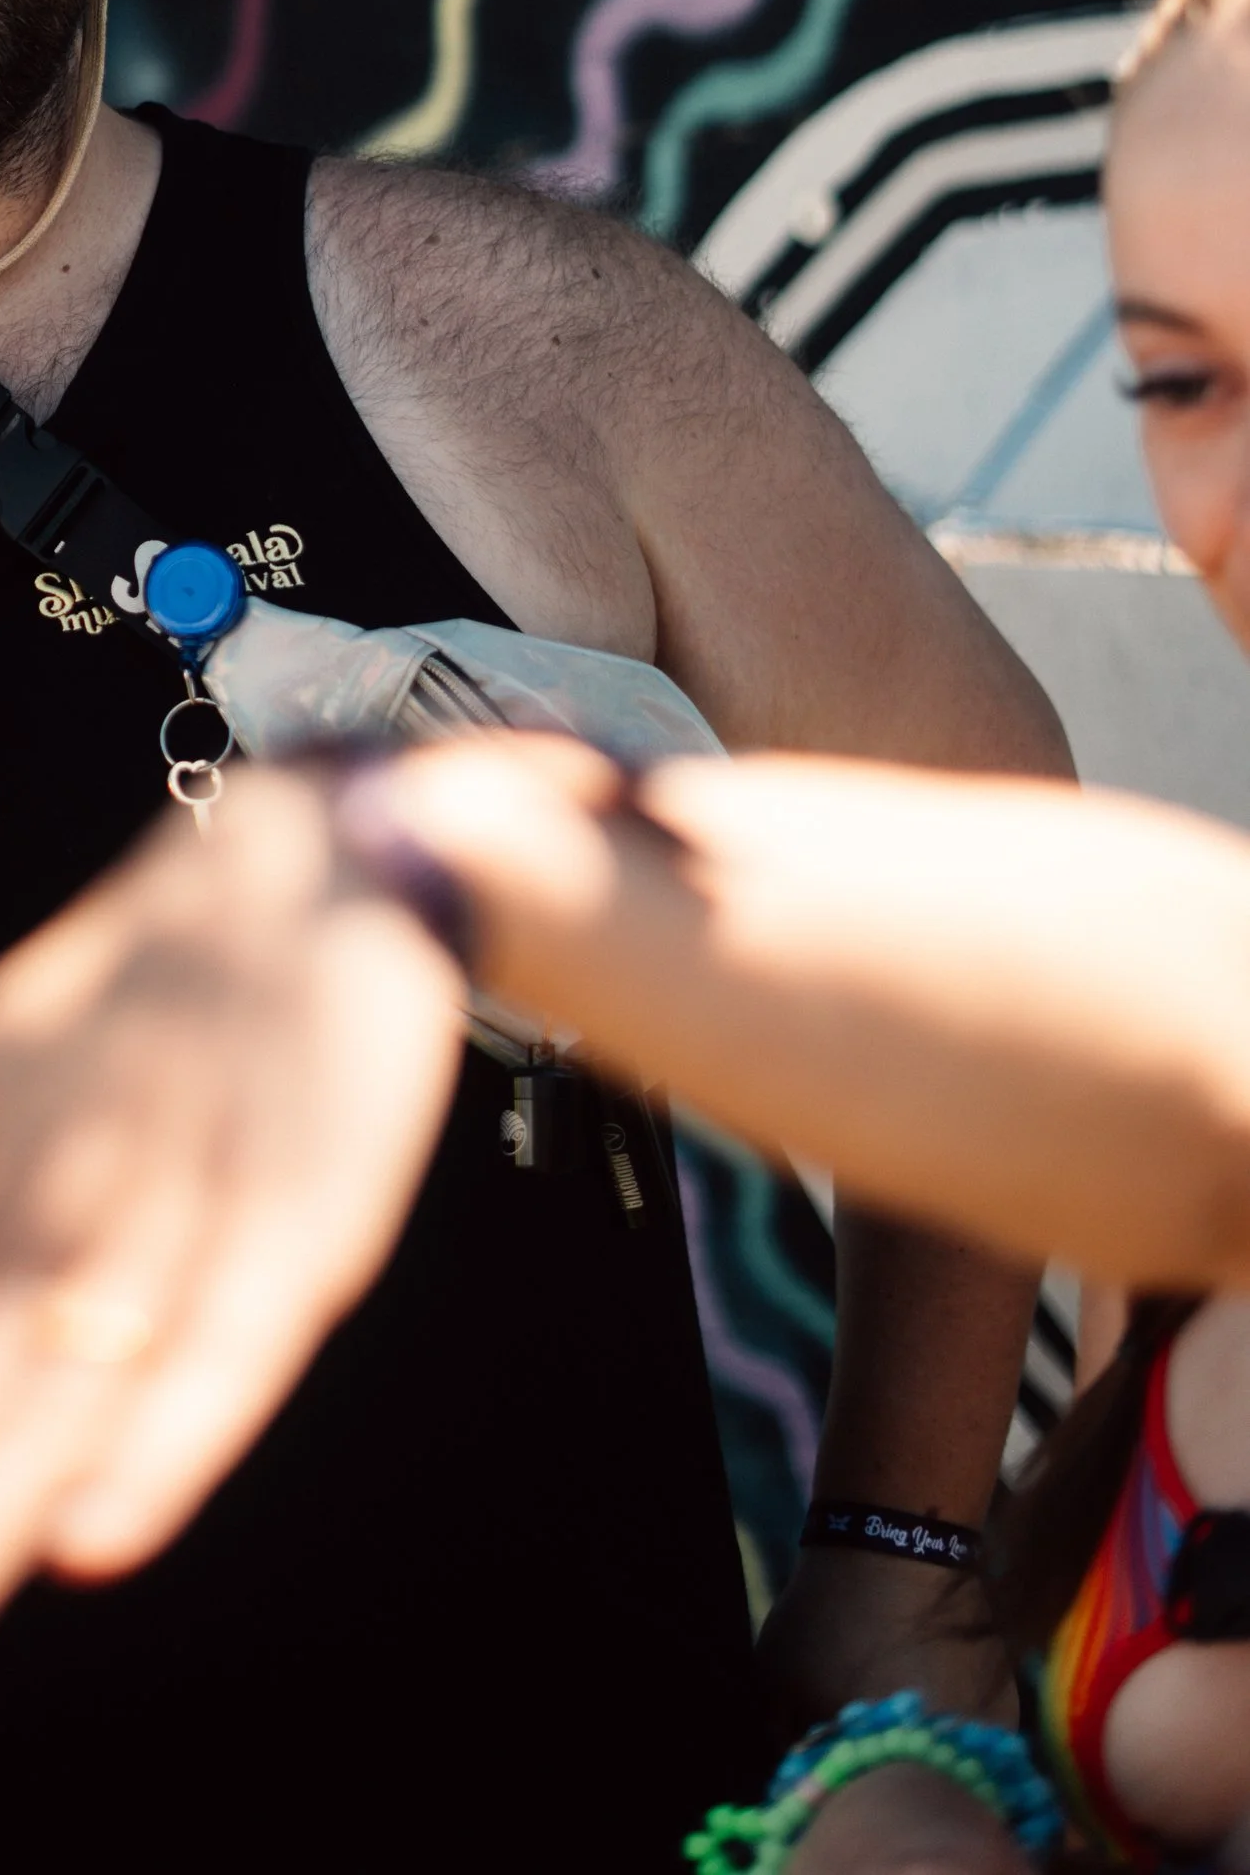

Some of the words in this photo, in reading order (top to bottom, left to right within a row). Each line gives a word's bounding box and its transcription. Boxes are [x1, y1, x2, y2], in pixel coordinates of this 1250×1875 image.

[612, 1153, 643, 1209] AUDIOVIA
[865, 1515, 909, 1547] Bring
[912, 1526, 945, 1555] Your
